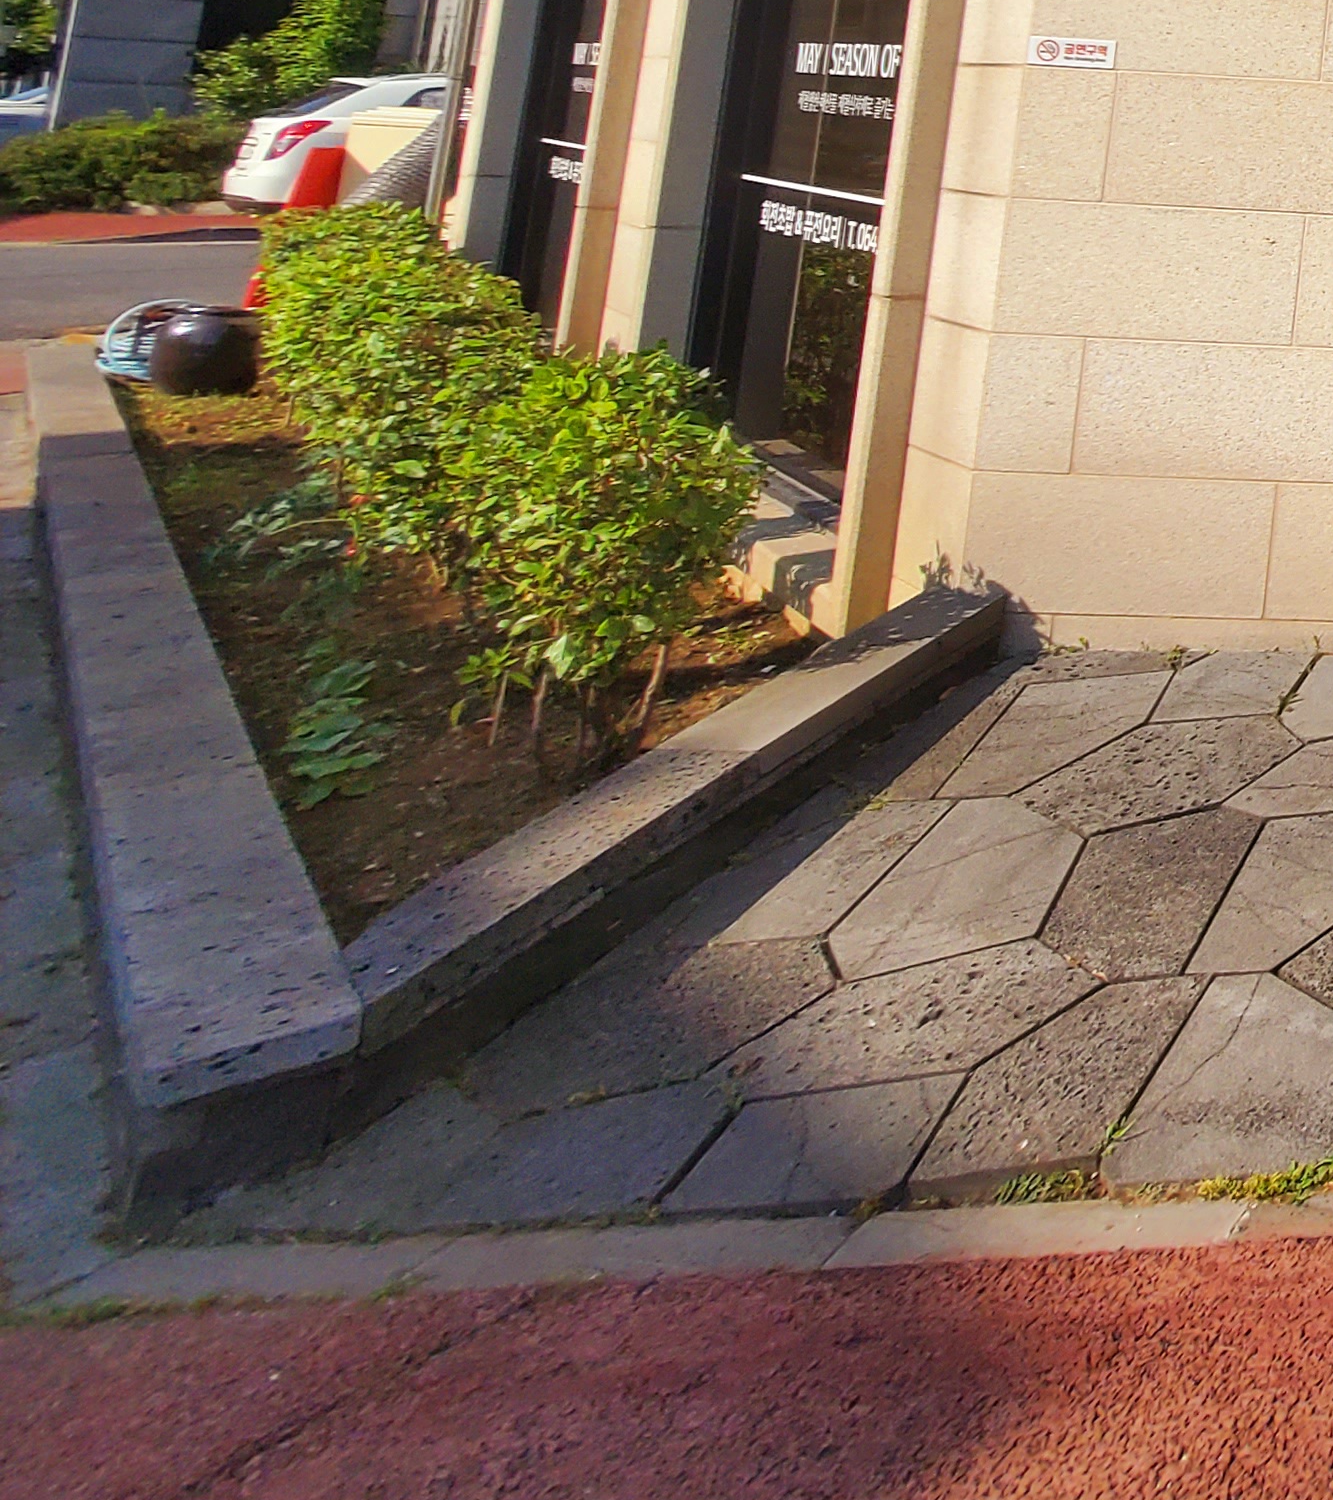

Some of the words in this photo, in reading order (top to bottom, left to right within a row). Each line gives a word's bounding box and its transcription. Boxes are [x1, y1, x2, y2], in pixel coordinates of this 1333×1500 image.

[795, 42, 823, 74] MAY
[829, 43, 881, 77] SEASON
[880, 44, 902, 79] OF
